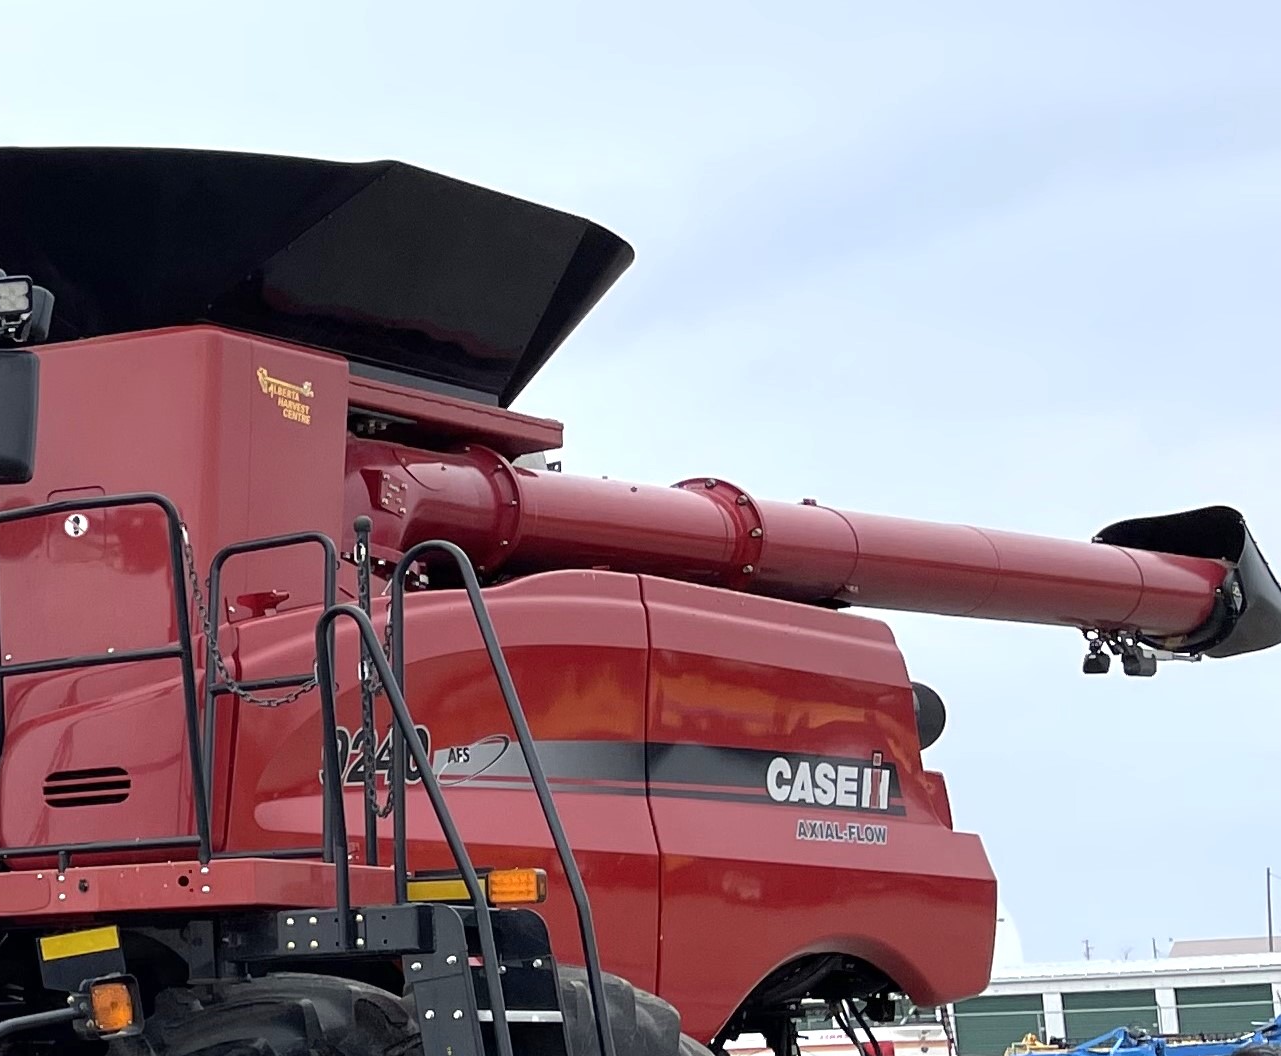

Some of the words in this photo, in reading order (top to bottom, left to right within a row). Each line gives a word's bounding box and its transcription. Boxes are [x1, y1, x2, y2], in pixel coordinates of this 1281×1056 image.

[268, 383, 300, 401] ALBERTA
[278, 397, 310, 415] HARVEST
[283, 408, 311, 425] CENTRE
[447, 746, 471, 764] AFS
[766, 756, 859, 807] CASE
[796, 819, 888, 845] AXIAL-FLOW
